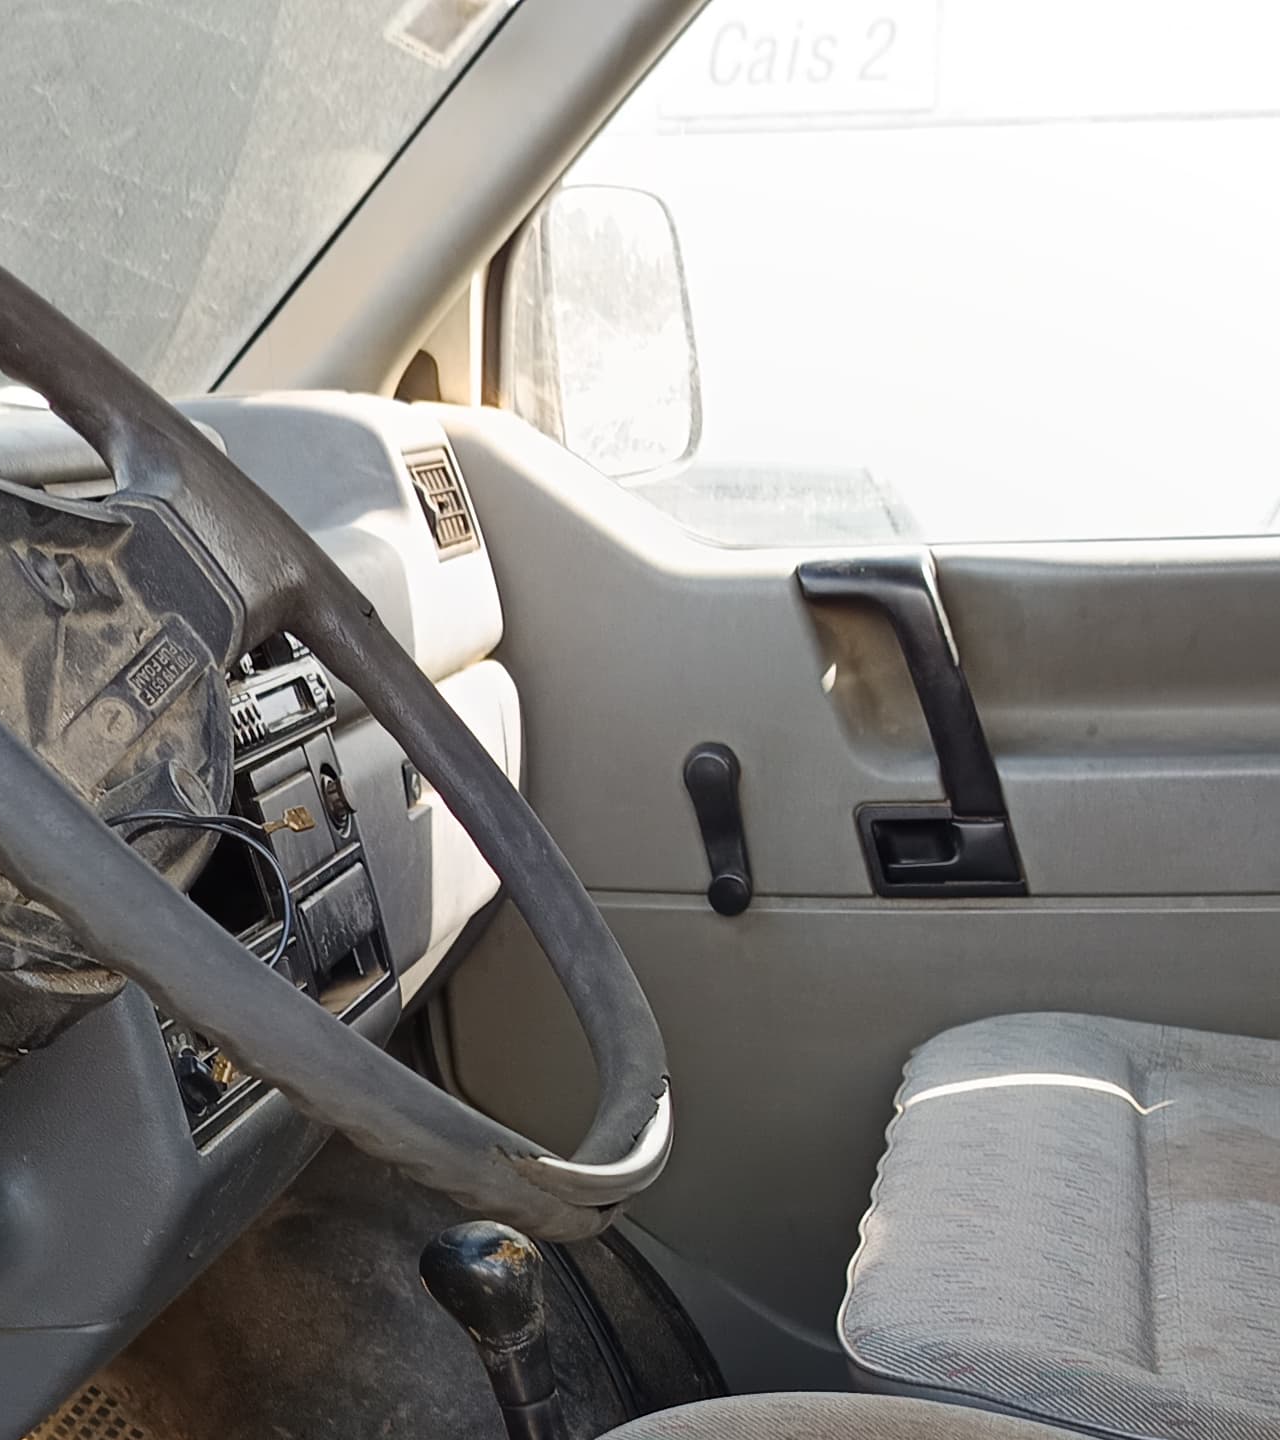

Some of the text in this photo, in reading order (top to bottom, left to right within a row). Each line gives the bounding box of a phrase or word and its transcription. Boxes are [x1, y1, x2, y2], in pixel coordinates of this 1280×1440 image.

[708, 16, 898, 87] Cais 2
[154, 643, 179, 665] PUR
